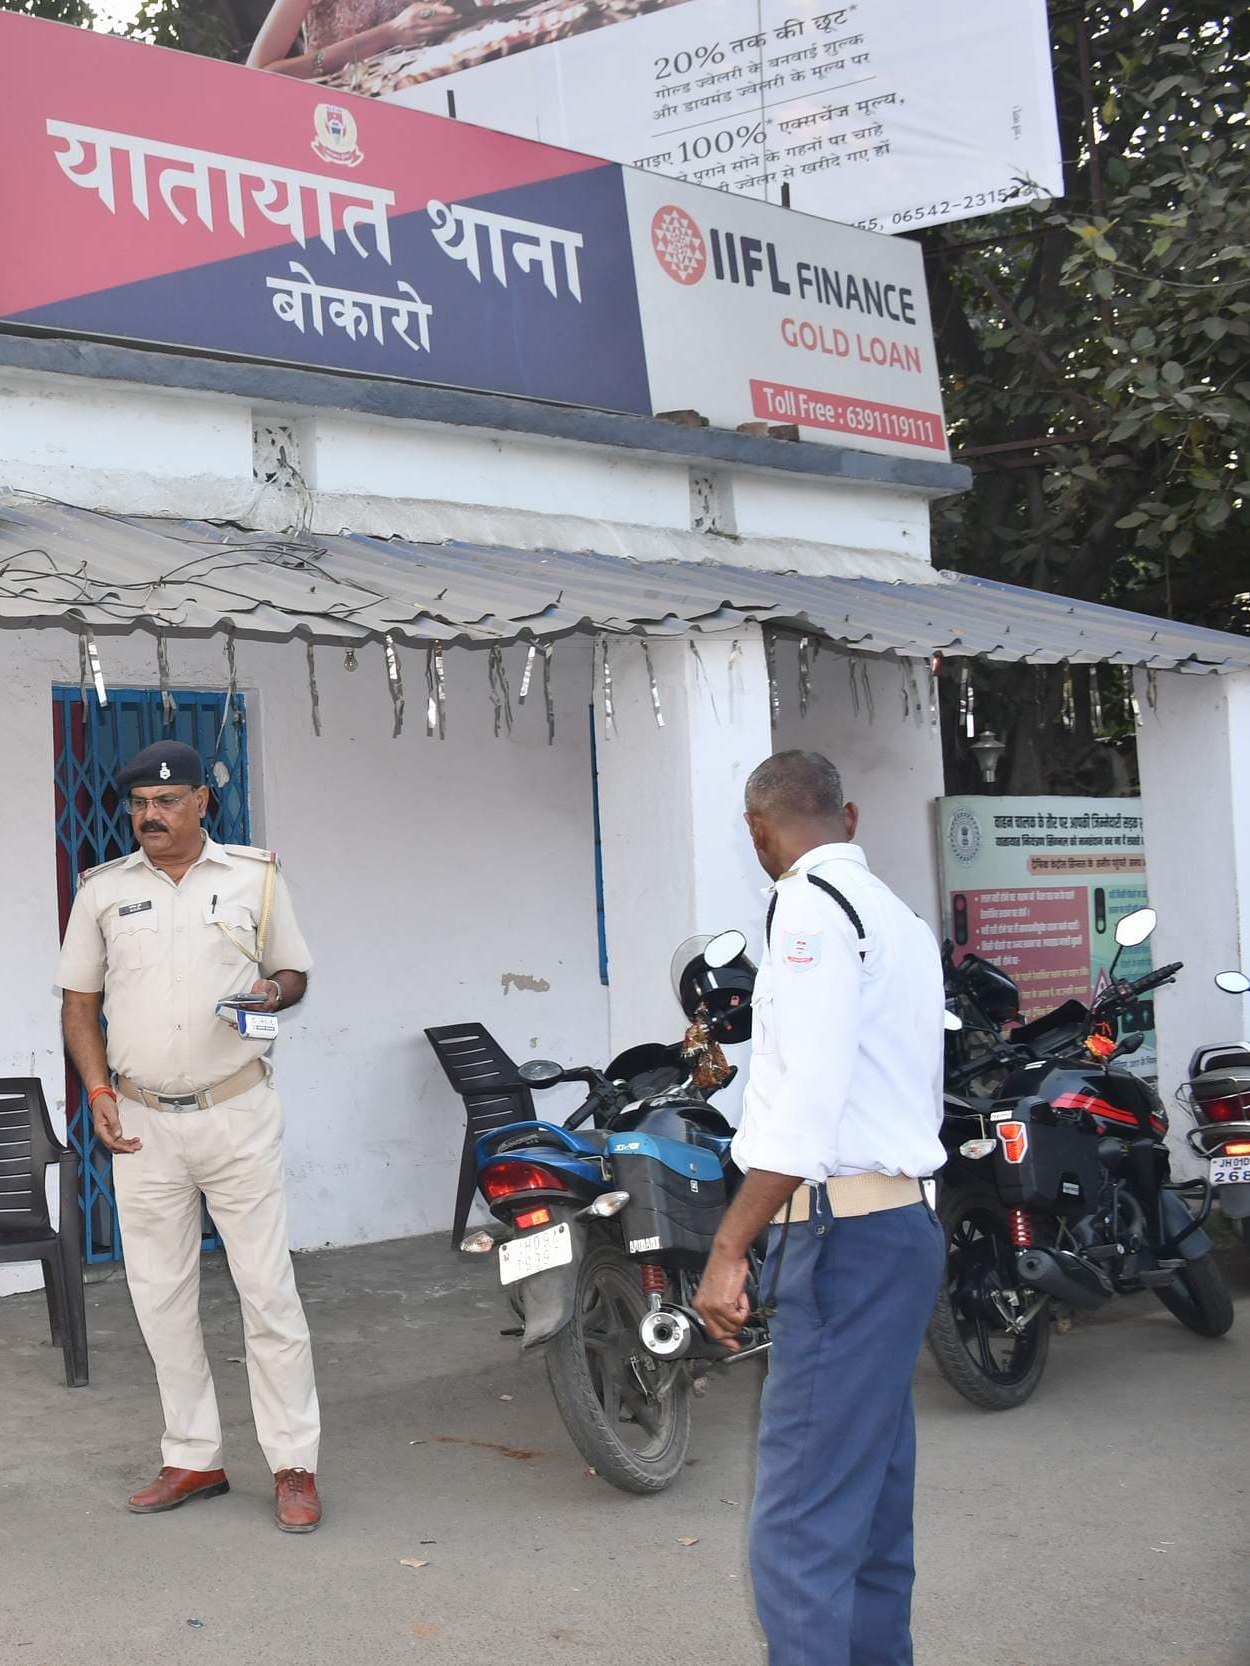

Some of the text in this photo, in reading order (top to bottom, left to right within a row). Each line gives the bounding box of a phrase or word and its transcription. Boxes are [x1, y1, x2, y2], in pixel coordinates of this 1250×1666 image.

[654, 43, 725, 80] 20%
[729, 32, 767, 54] तक
[774, 18, 804, 41] की
[654, 80, 691, 99] गोल्ड
[695, 66, 743, 89] ज्वेलरी
[748, 61, 762, 75] के
[822, 33, 864, 55] शुल्क
[652, 52, 870, 121] और डायमंड ज्वेलरी के मूल्य पर
[731, 152, 760, 172] सोने
[763, 148, 781, 163] के
[785, 134, 822, 158] गहनों
[827, 133, 847, 149] पर
[853, 121, 884, 141] चाहे
[734, 172, 778, 190] ज्वेलर
[781, 164, 795, 179] से
[800, 151, 841, 174] खरीदे
[845, 149, 869, 164] गए
[873, 138, 891, 157] हों
[46, 118, 584, 304] यातायात थाना
[265, 261, 433, 353] बोकारो
[709, 228, 916, 325] IIFL FINANCE
[781, 317, 922, 374] GOLD LOAN
[762, 387, 796, 416] Toll
[798, 394, 835, 423] Free
[846, 406, 934, 443] 6391119111
